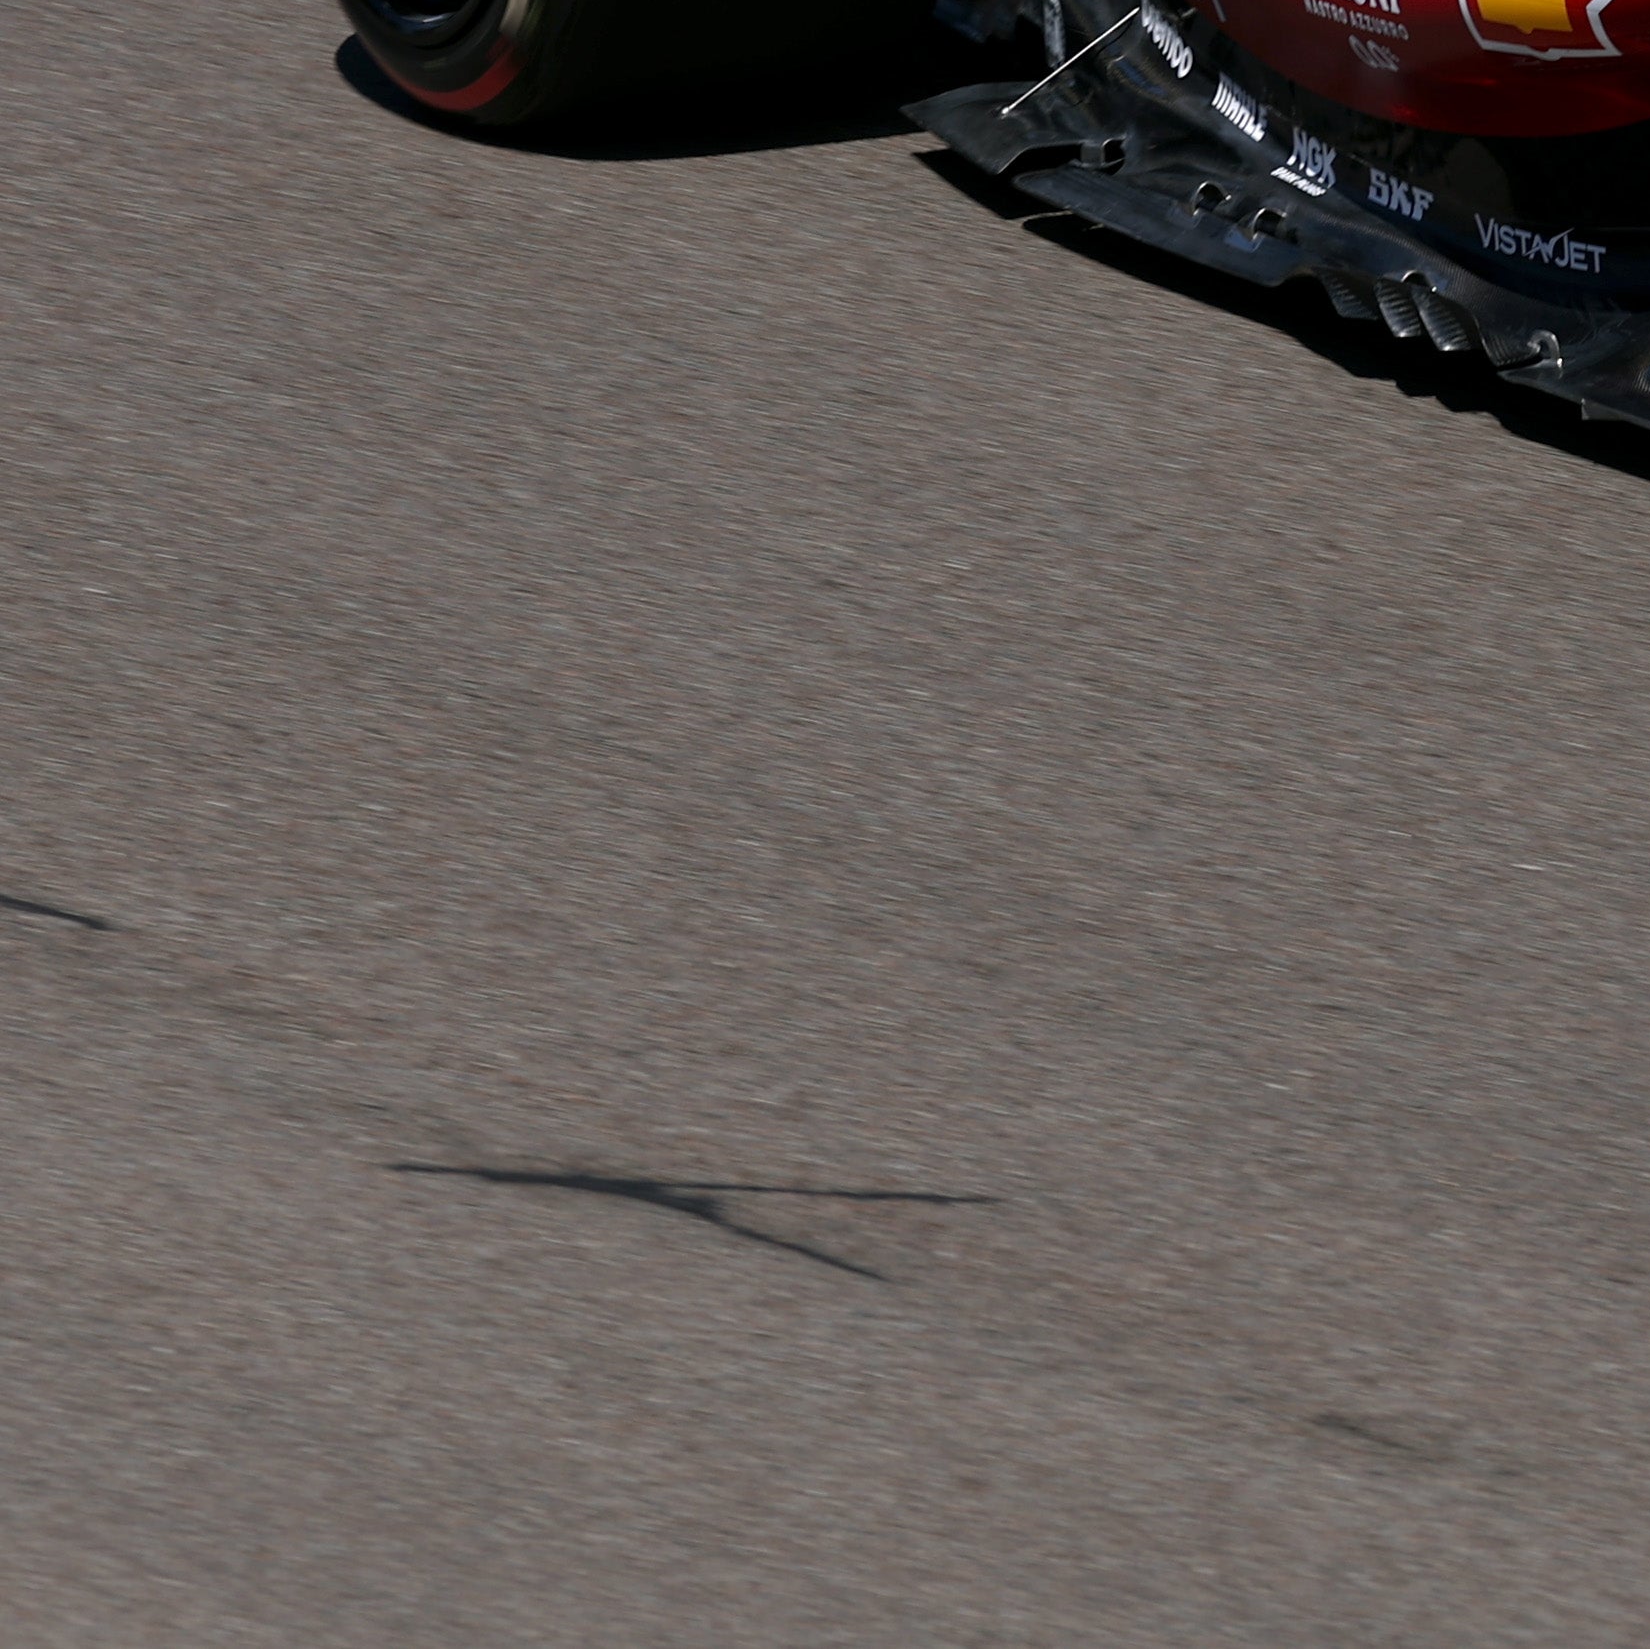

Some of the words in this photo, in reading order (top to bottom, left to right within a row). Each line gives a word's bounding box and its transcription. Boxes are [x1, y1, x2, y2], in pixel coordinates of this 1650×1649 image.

[1350, 11, 1409, 41] AZZURRO
[1286, 126, 1337, 190] NGK
[1368, 167, 1435, 222] SKF
